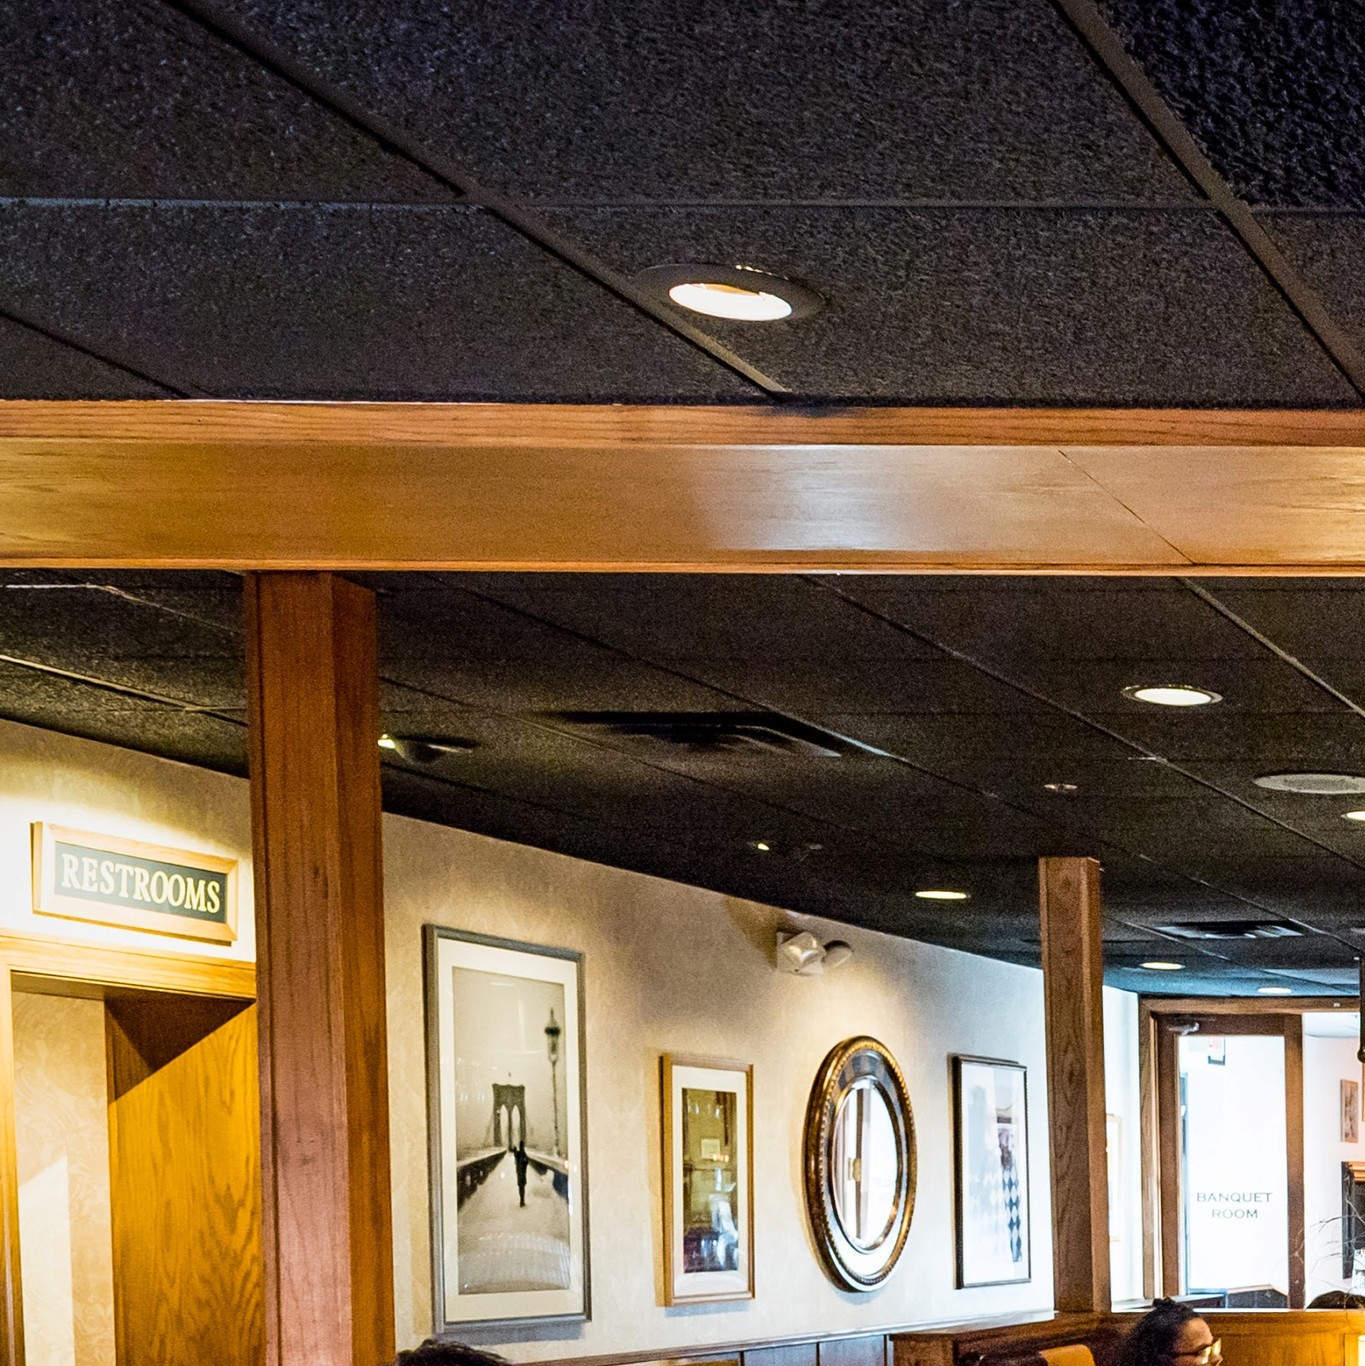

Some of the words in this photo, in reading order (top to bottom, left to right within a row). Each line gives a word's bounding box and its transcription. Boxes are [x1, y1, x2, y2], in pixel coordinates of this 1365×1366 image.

[61, 853, 221, 914] RESTROOMS
[1196, 1192, 1273, 1203] BANQUET
[1211, 1209, 1258, 1219] ROOM
